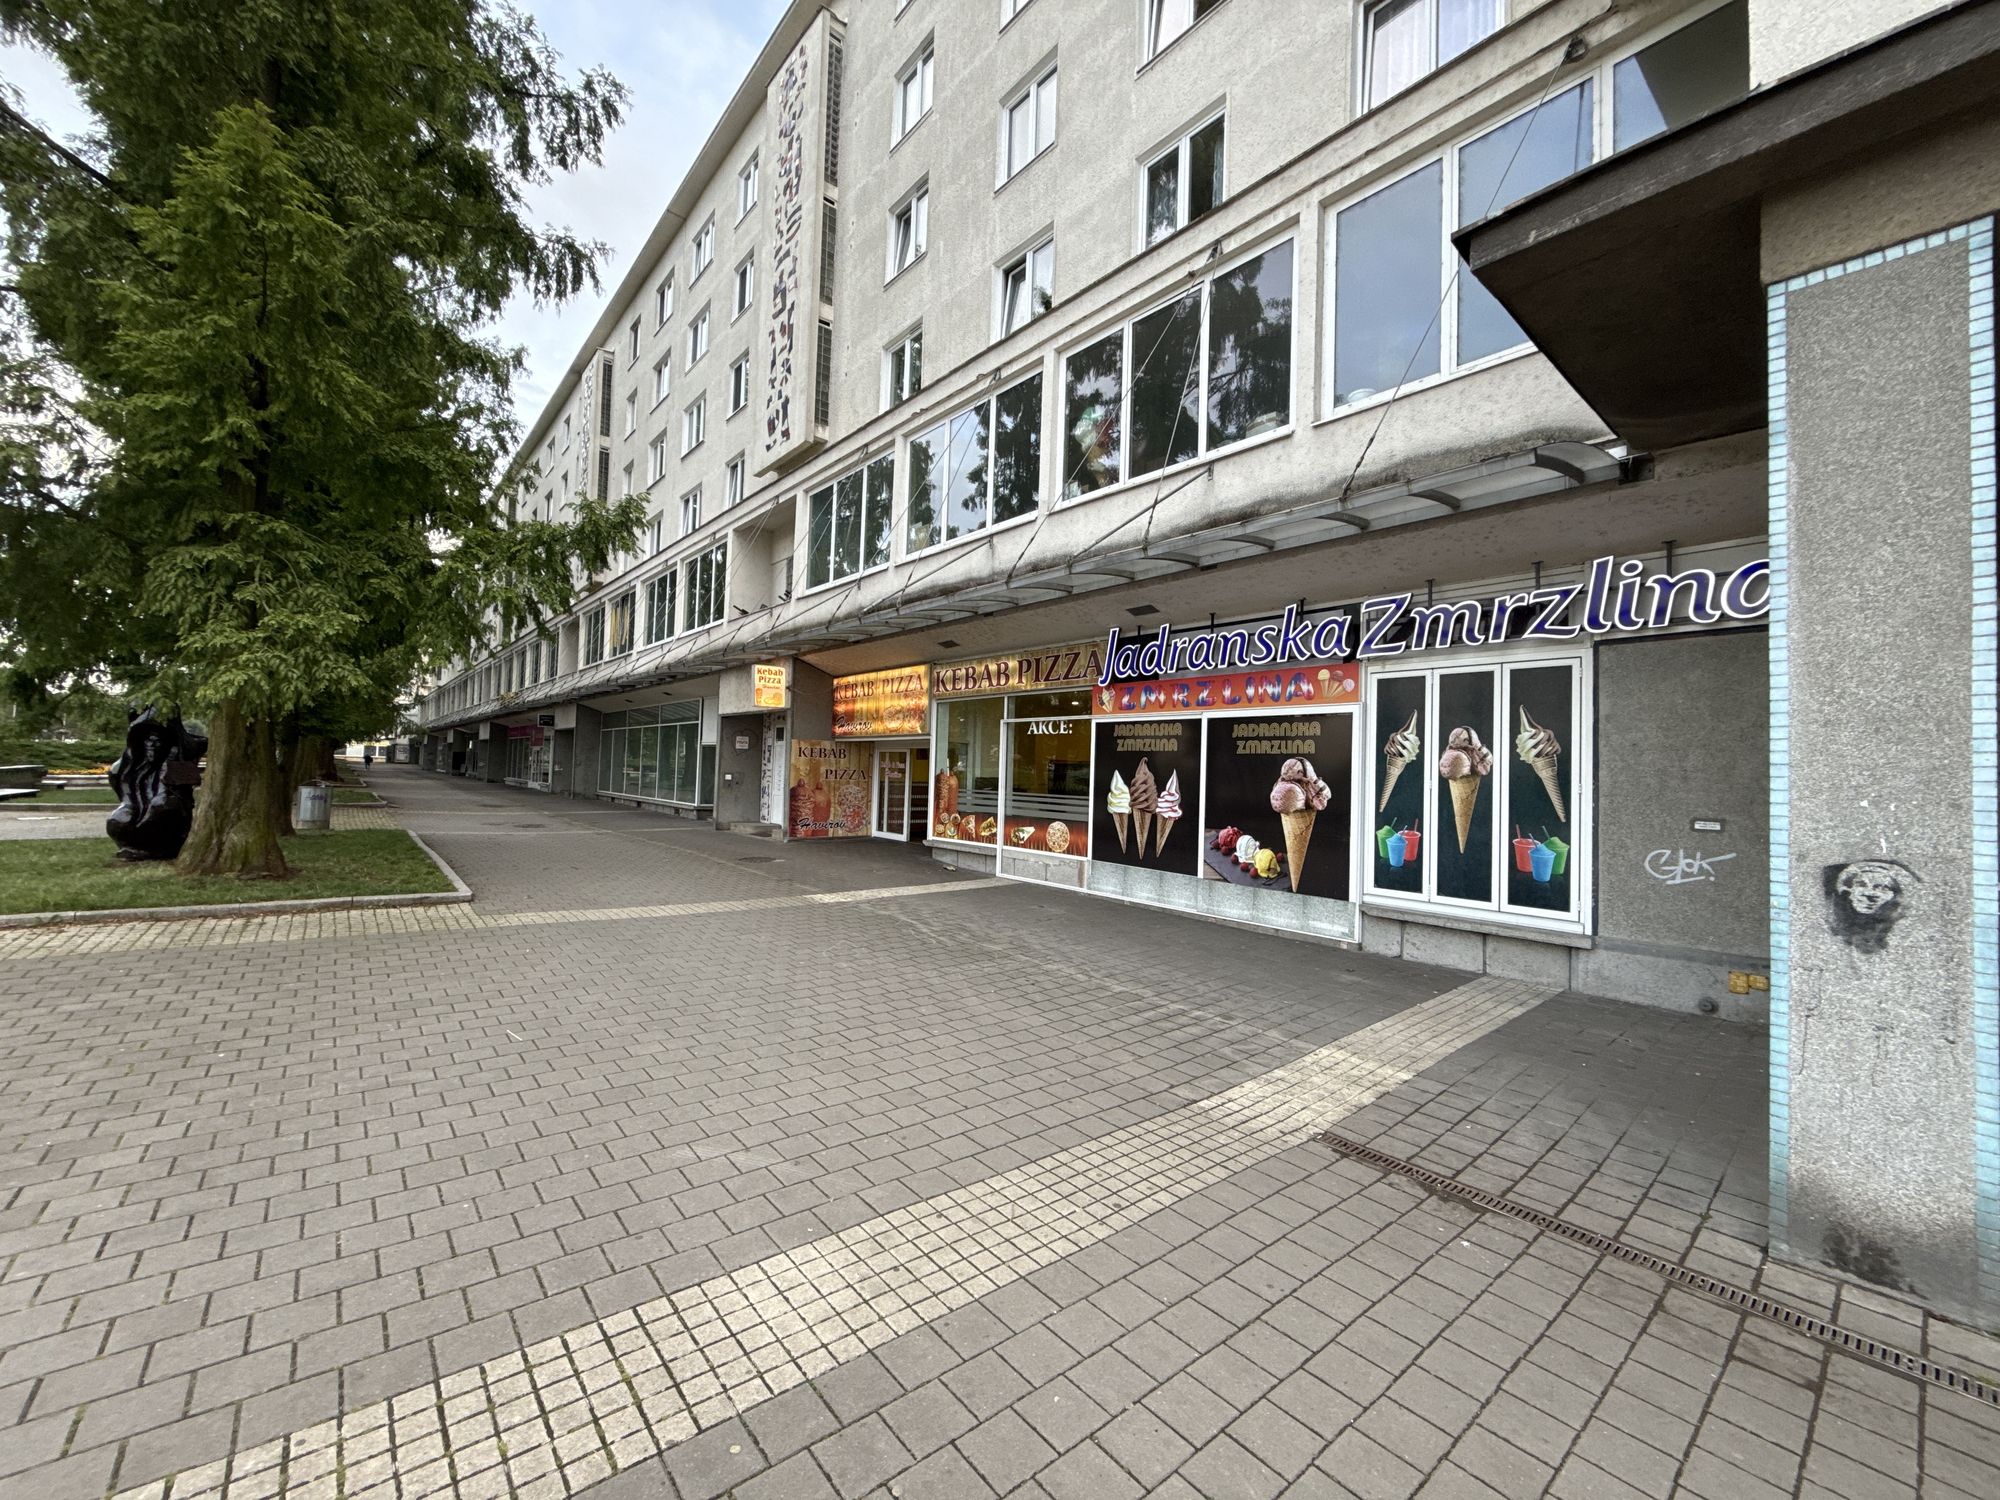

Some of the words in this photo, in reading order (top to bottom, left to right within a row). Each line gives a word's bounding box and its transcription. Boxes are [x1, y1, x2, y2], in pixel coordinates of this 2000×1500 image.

[1098, 604, 1352, 687] Jadranska
[756, 667, 783, 676] Kebab
[934, 661, 1010, 694] KEBAB
[1016, 649, 1104, 684] PIZZA
[758, 676, 781, 684] Pizza
[833, 681, 874, 700] KEBAB
[882, 674, 923, 694] PIZZA
[1118, 669, 1315, 711] ZMRZLINA
[1027, 720, 1073, 735] AKCE:
[1113, 722, 1182, 737] JADRANSKA
[1231, 721, 1321, 738] JADRANSKA
[1116, 738, 1178, 752] ZMRZLINA
[1236, 739, 1316, 755] ZMRZLINA
[798, 747, 847, 759] KEBAB
[825, 769, 866, 780] PIZZA
